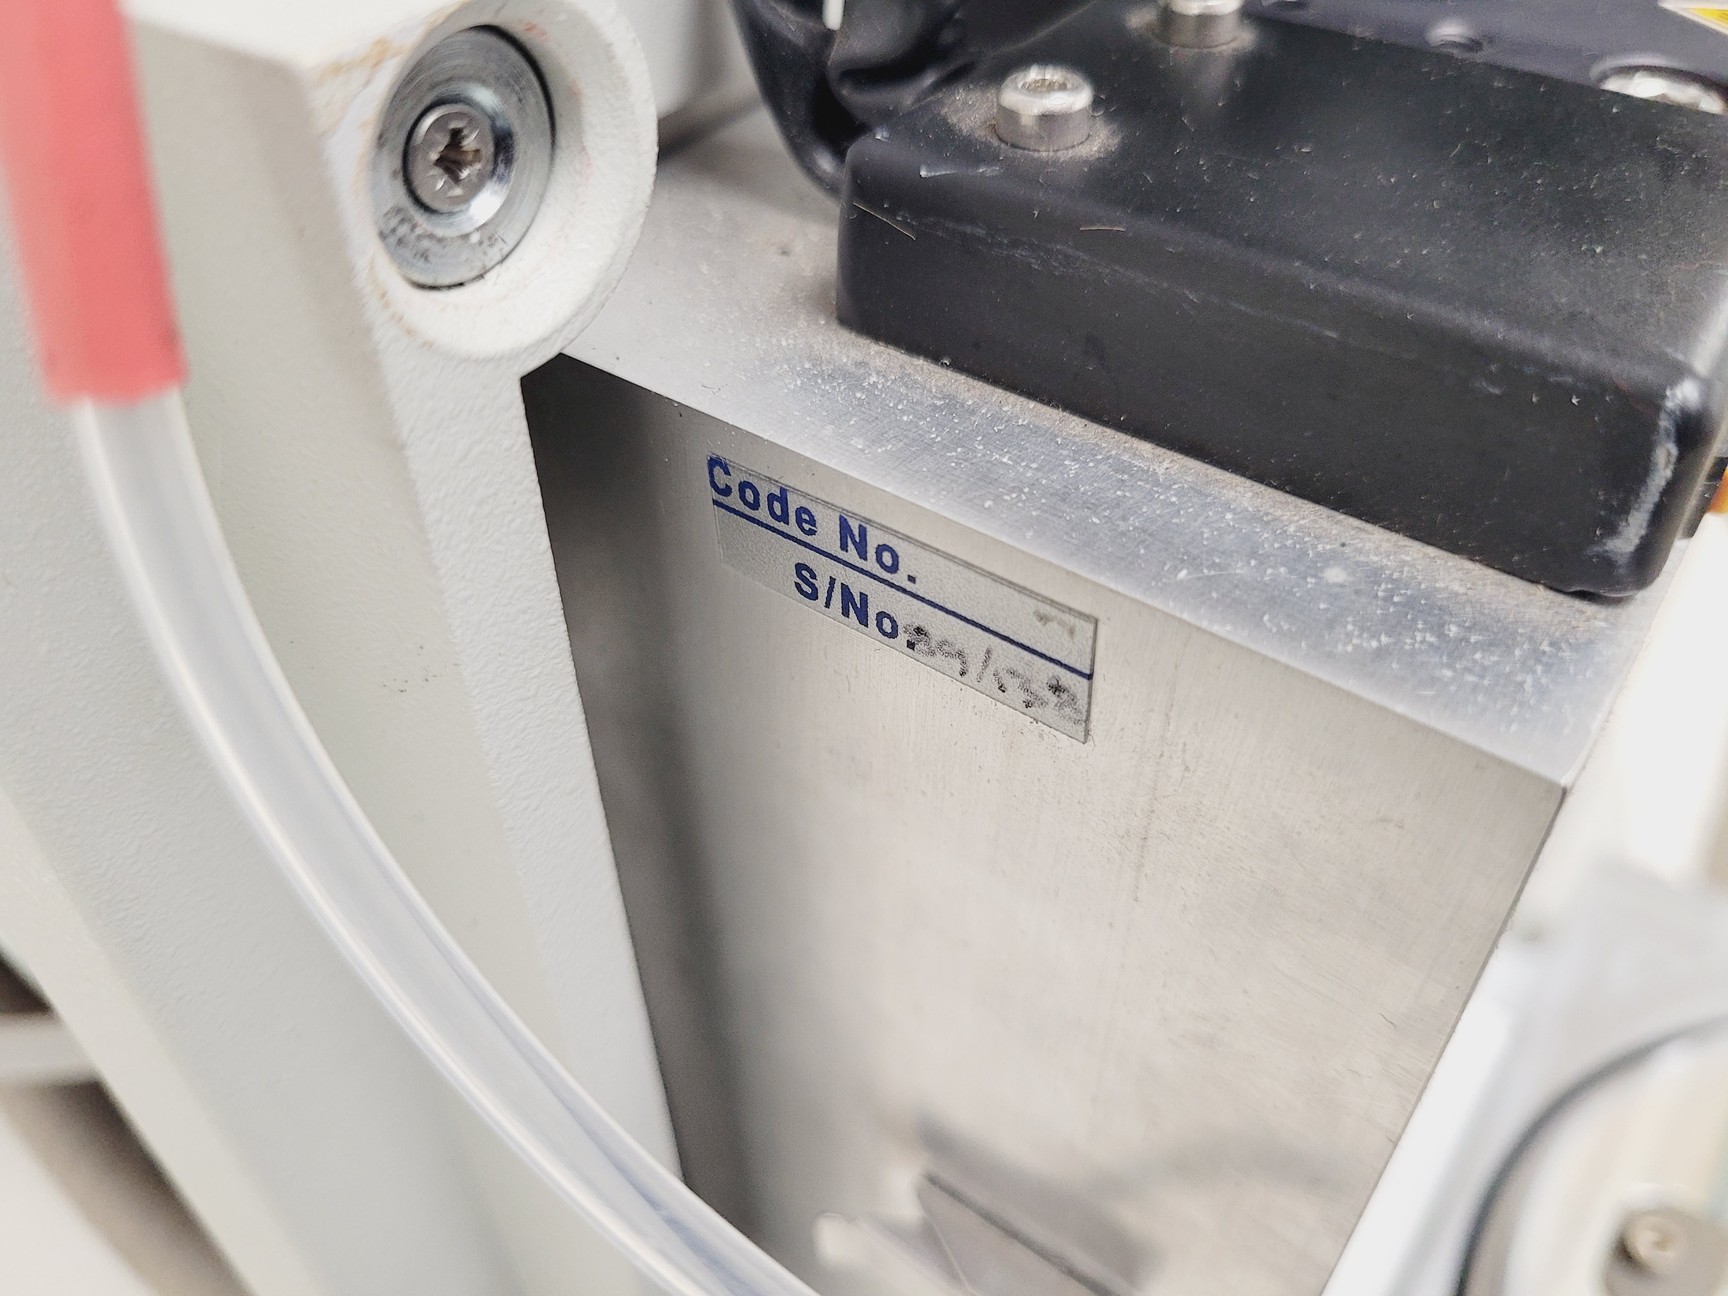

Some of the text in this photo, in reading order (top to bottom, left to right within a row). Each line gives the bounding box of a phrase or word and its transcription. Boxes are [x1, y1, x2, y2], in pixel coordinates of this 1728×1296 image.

[708, 456, 917, 584] Code No.
[795, 562, 916, 650] S/No.
